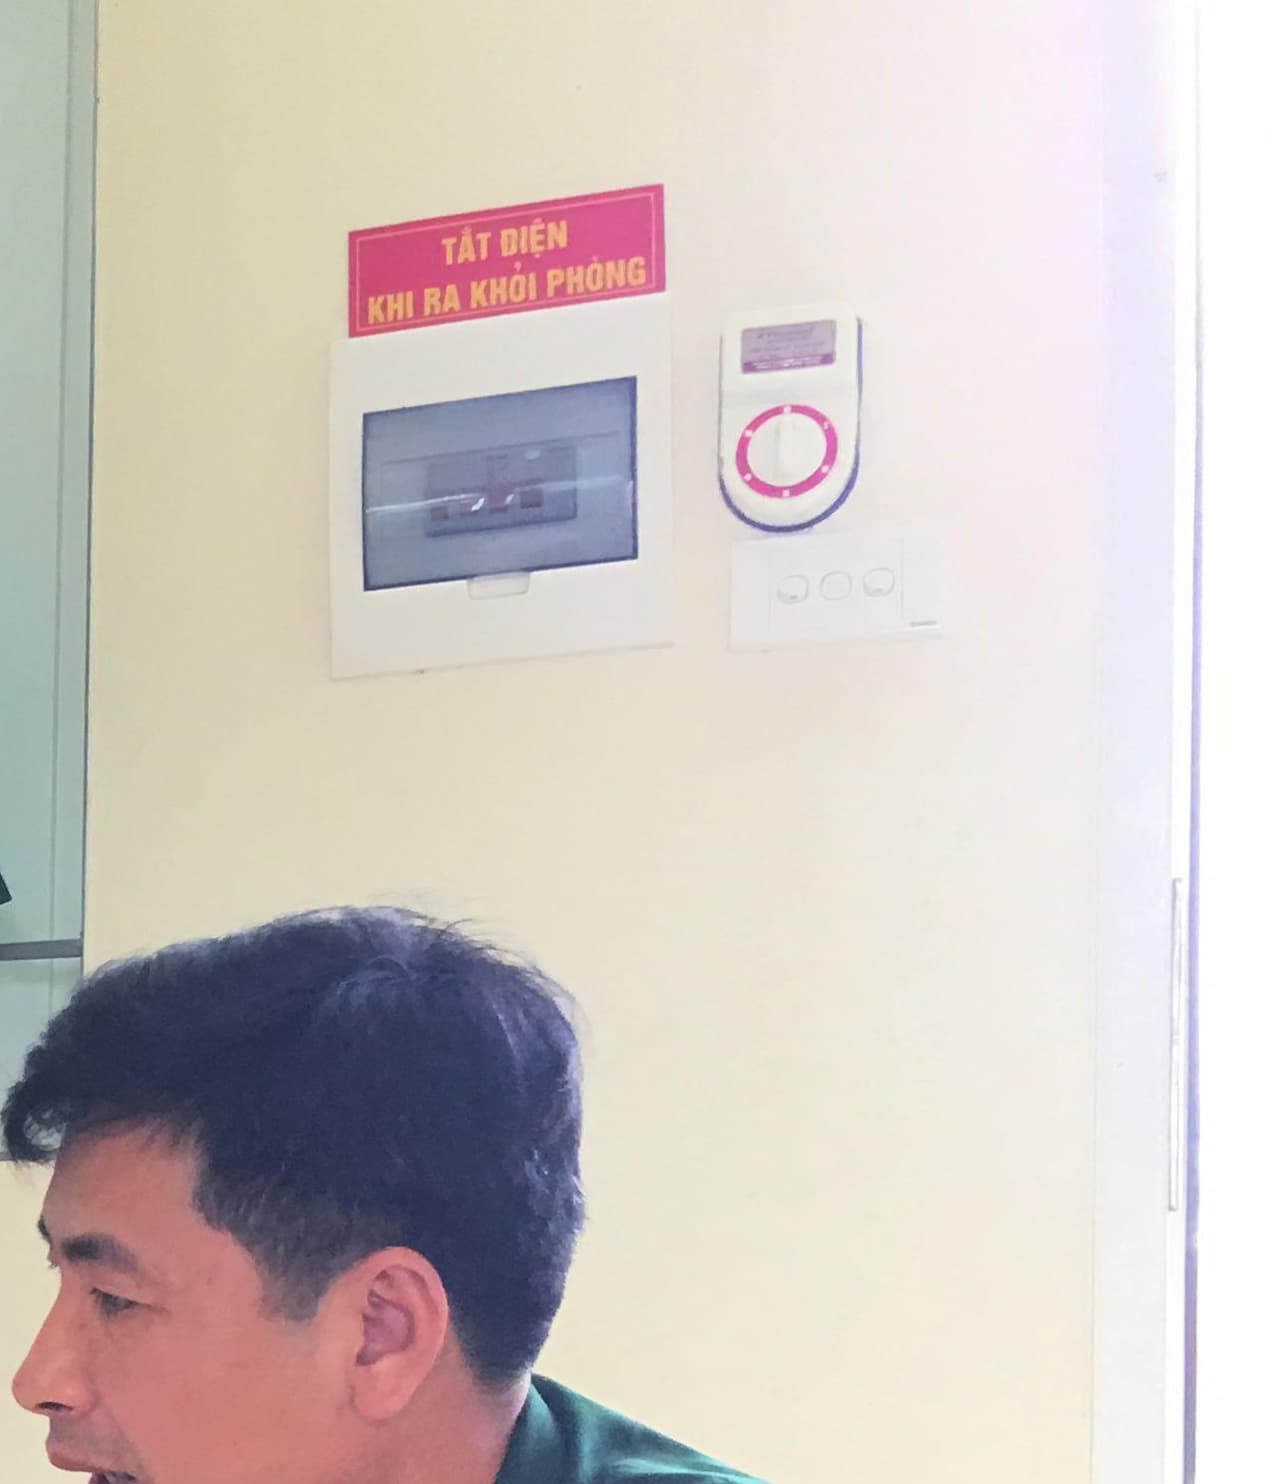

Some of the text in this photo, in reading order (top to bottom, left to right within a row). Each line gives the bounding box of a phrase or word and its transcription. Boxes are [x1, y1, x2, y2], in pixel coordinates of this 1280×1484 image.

[442, 218, 568, 265] TẮT ĐIỆN
[367, 255, 647, 324] KHI RA KHỎI PHÒNG
